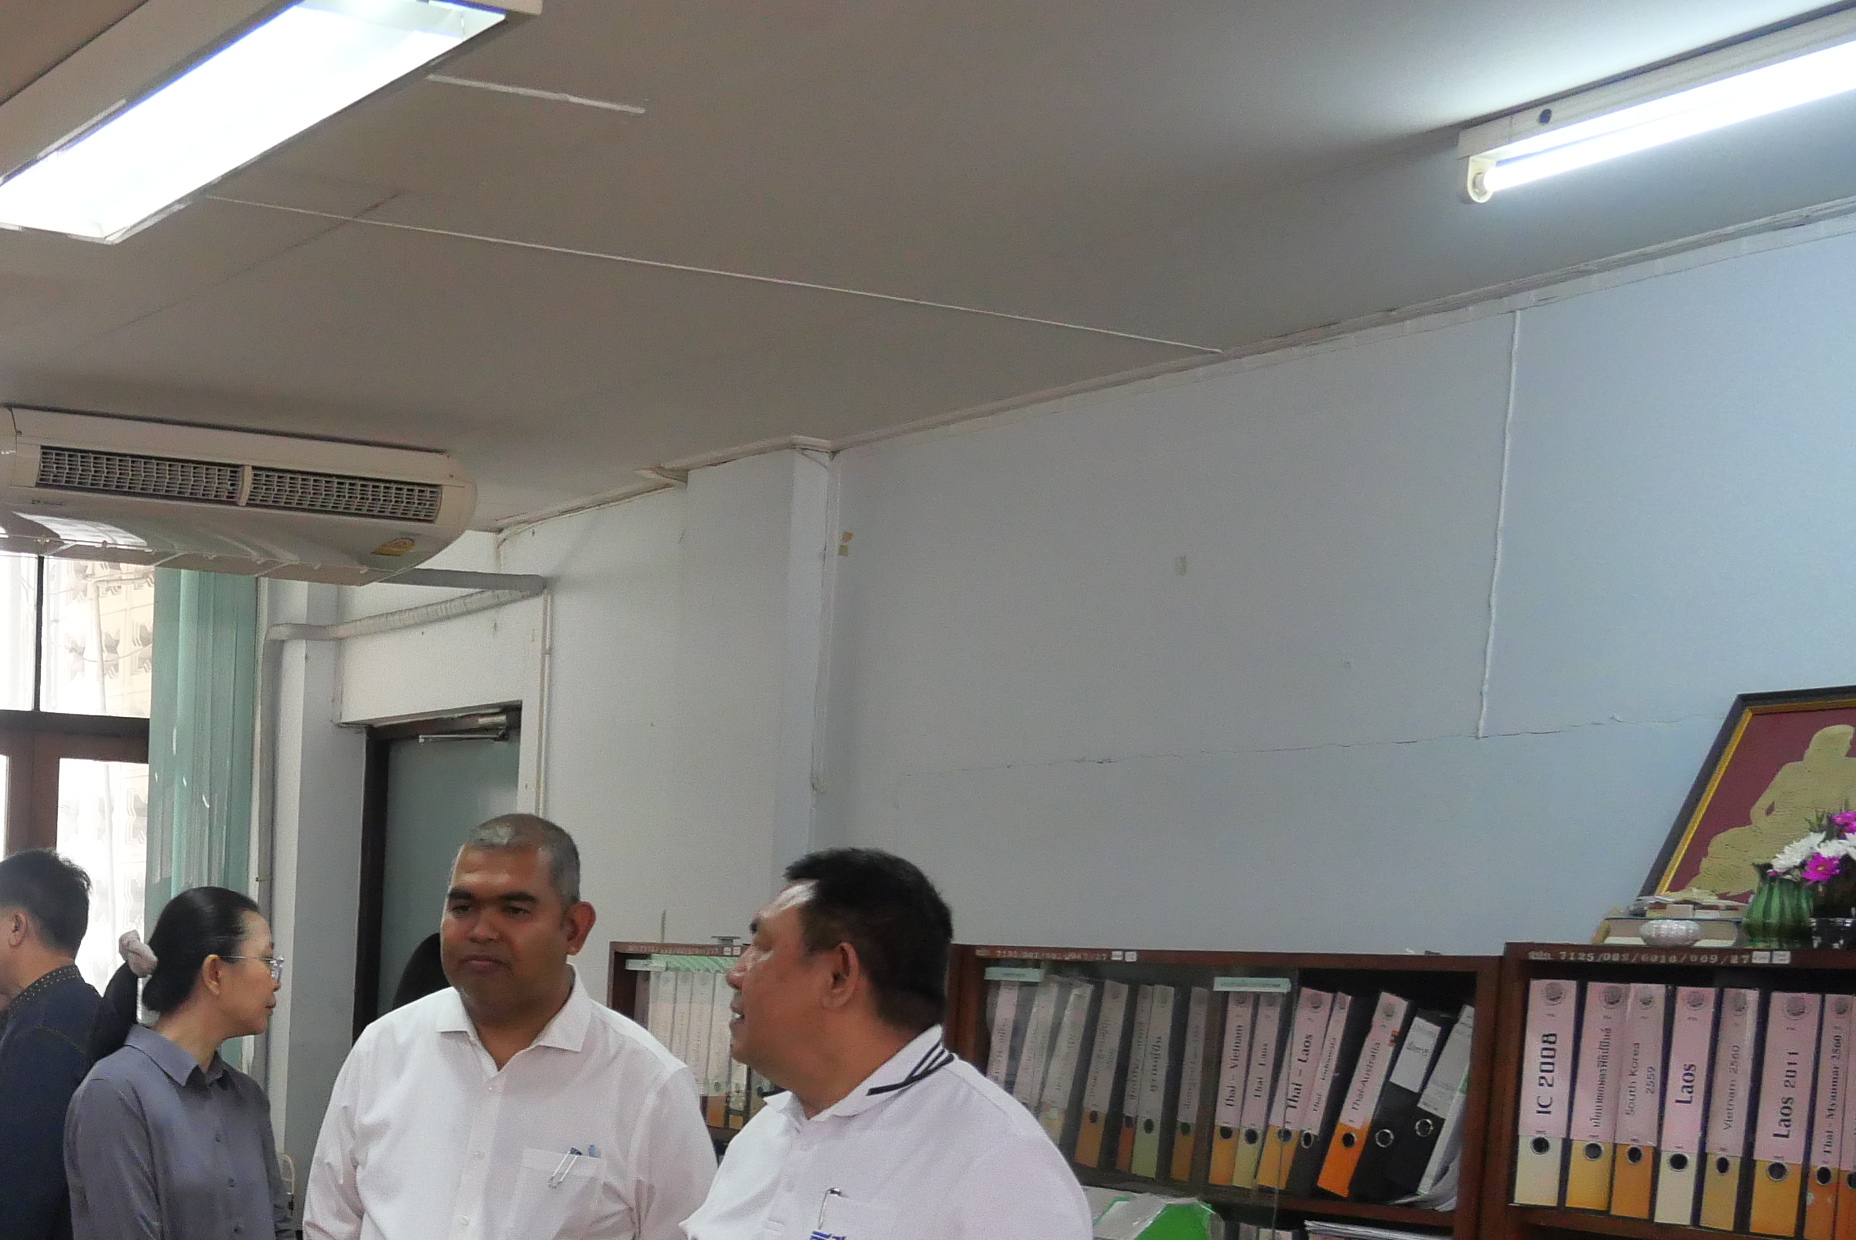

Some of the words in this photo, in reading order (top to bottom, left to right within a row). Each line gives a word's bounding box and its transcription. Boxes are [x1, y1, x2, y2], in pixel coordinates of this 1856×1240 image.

[1230, 1025, 1243, 1069] Vietnam
[1538, 1033, 1557, 1087] 2008
[1287, 1082, 1303, 1109] Thai
[1297, 1034, 1313, 1064] Laos
[1675, 1063, 1697, 1105] Laos
[1772, 1096, 1794, 1139] Laos
[1784, 1051, 1799, 1088] 2011
[1536, 1096, 1553, 1115] IC
[1625, 1081, 1637, 1116] South
[1723, 1079, 1737, 1131] Vietnam
